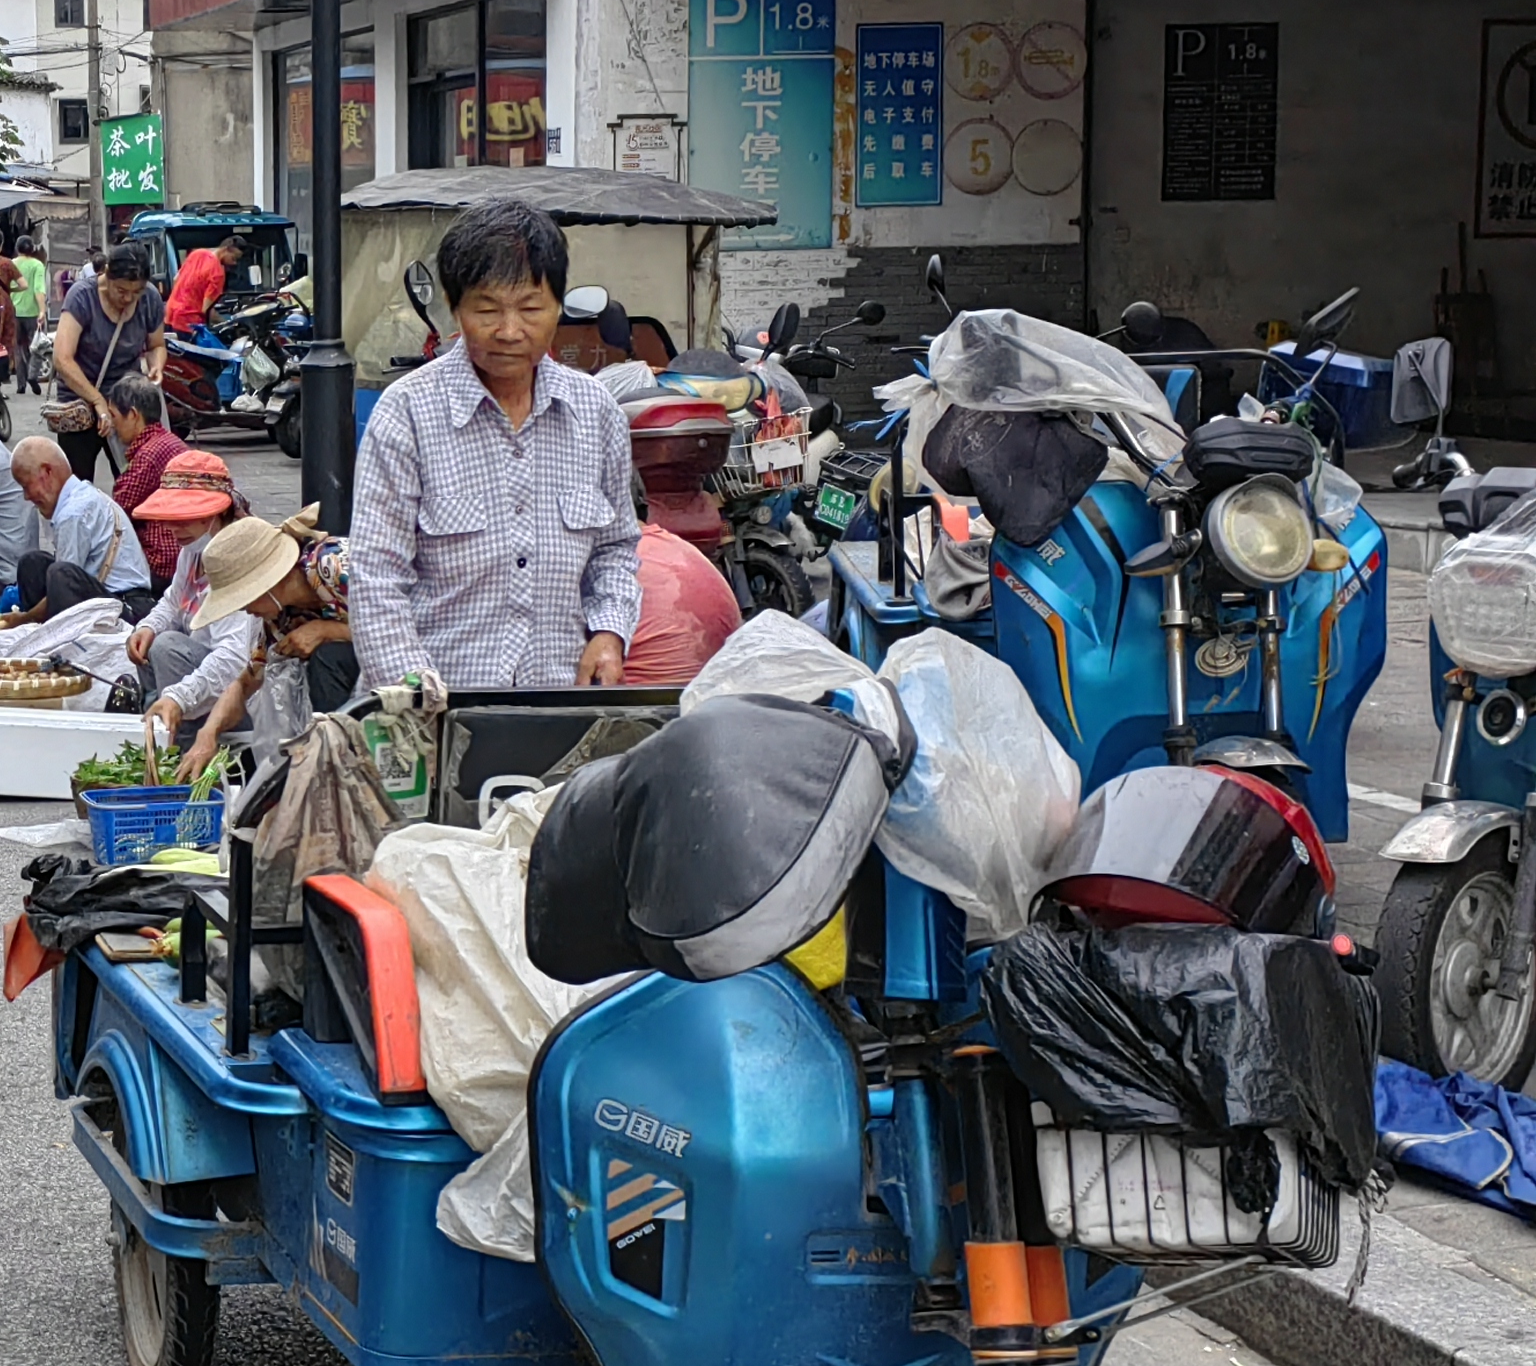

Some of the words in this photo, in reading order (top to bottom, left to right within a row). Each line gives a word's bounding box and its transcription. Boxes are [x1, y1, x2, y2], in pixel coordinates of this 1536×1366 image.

[864, 51, 935, 69] 地下停车场
[1173, 29, 1206, 76] P
[864, 79, 935, 96] 无人值守
[864, 107, 935, 124] 电子支付
[106, 124, 157, 157] 茶叶
[739, 66, 783, 205] 地下停车
[863, 134, 935, 152] 先缴费
[970, 139, 992, 176] 5
[107, 162, 159, 193] 批发
[863, 162, 935, 180] 后取车
